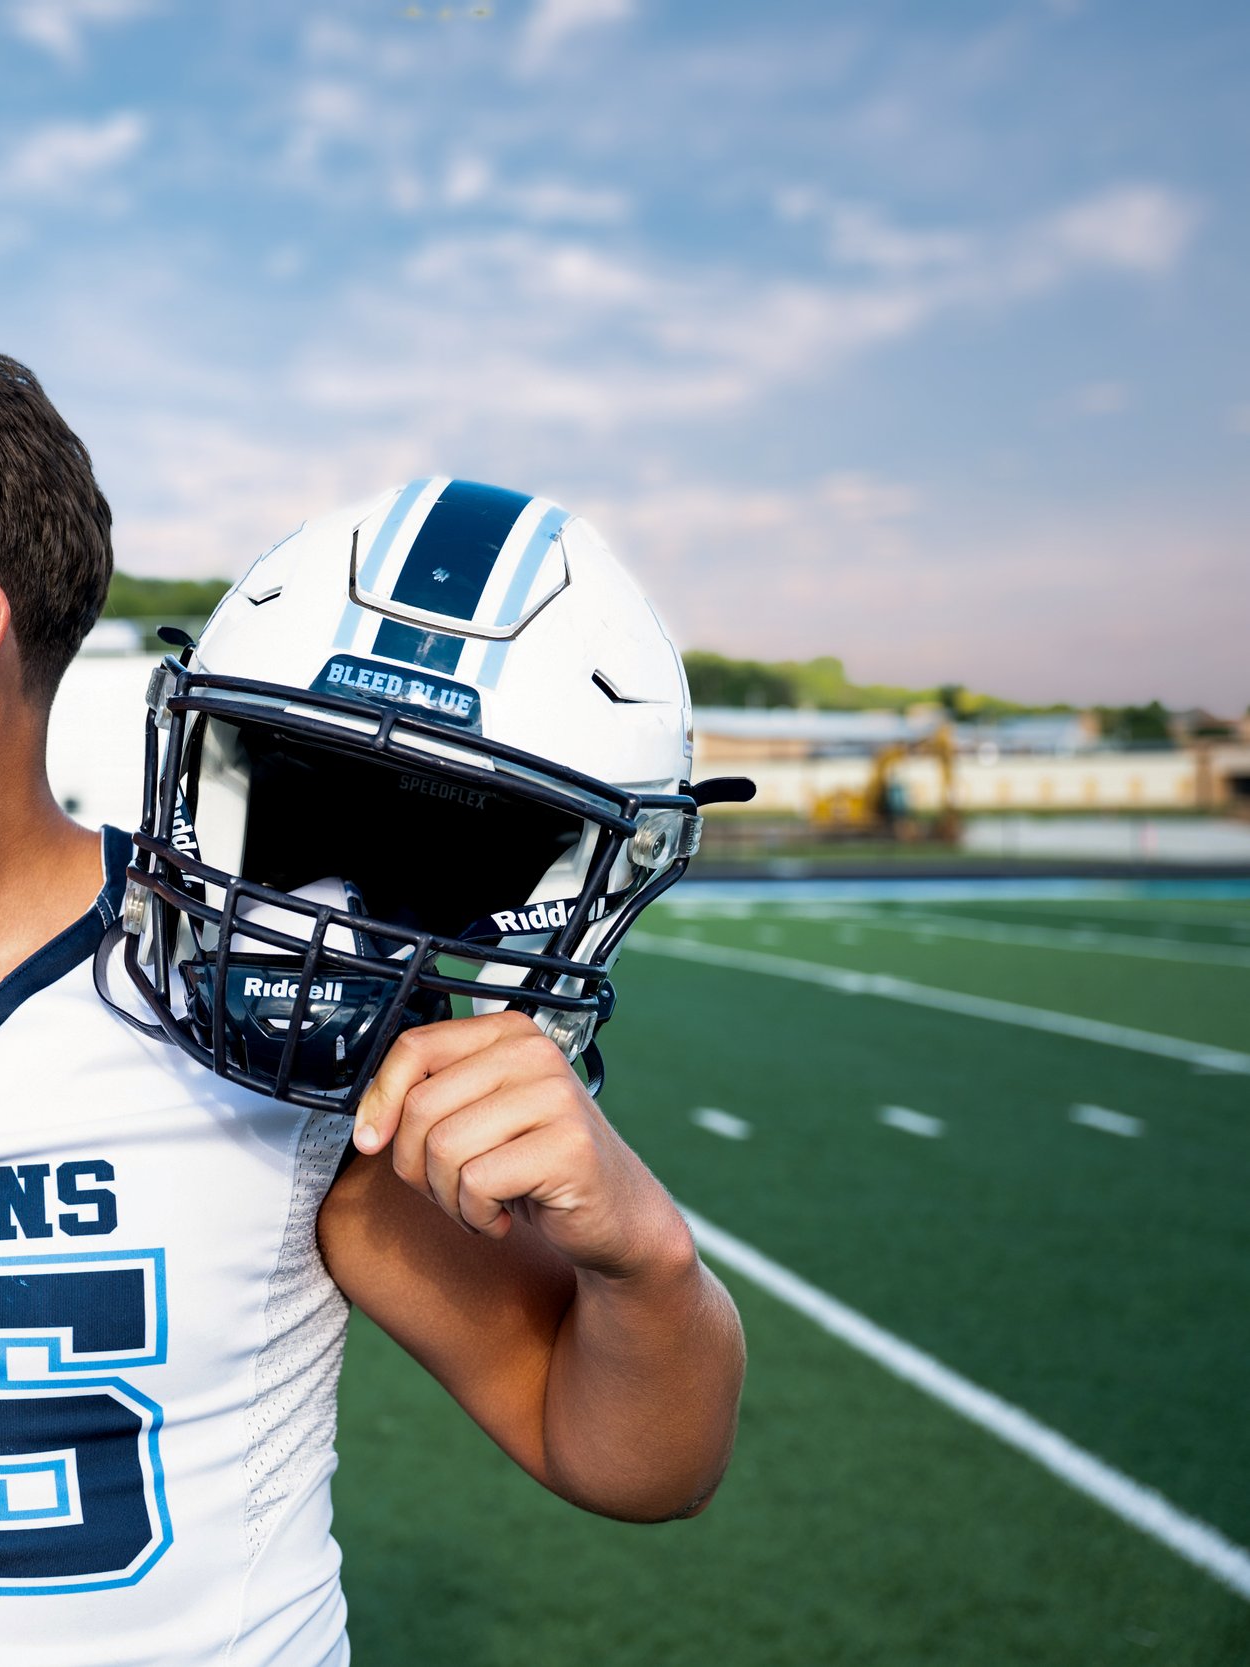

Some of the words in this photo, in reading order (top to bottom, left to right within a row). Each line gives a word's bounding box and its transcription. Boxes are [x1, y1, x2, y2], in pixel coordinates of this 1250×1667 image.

[326, 663, 403, 696] BLEED
[406, 680, 473, 715] BLUE
[399, 774, 486, 810] SPEEDFLEX
[490, 897, 606, 932] Riddll
